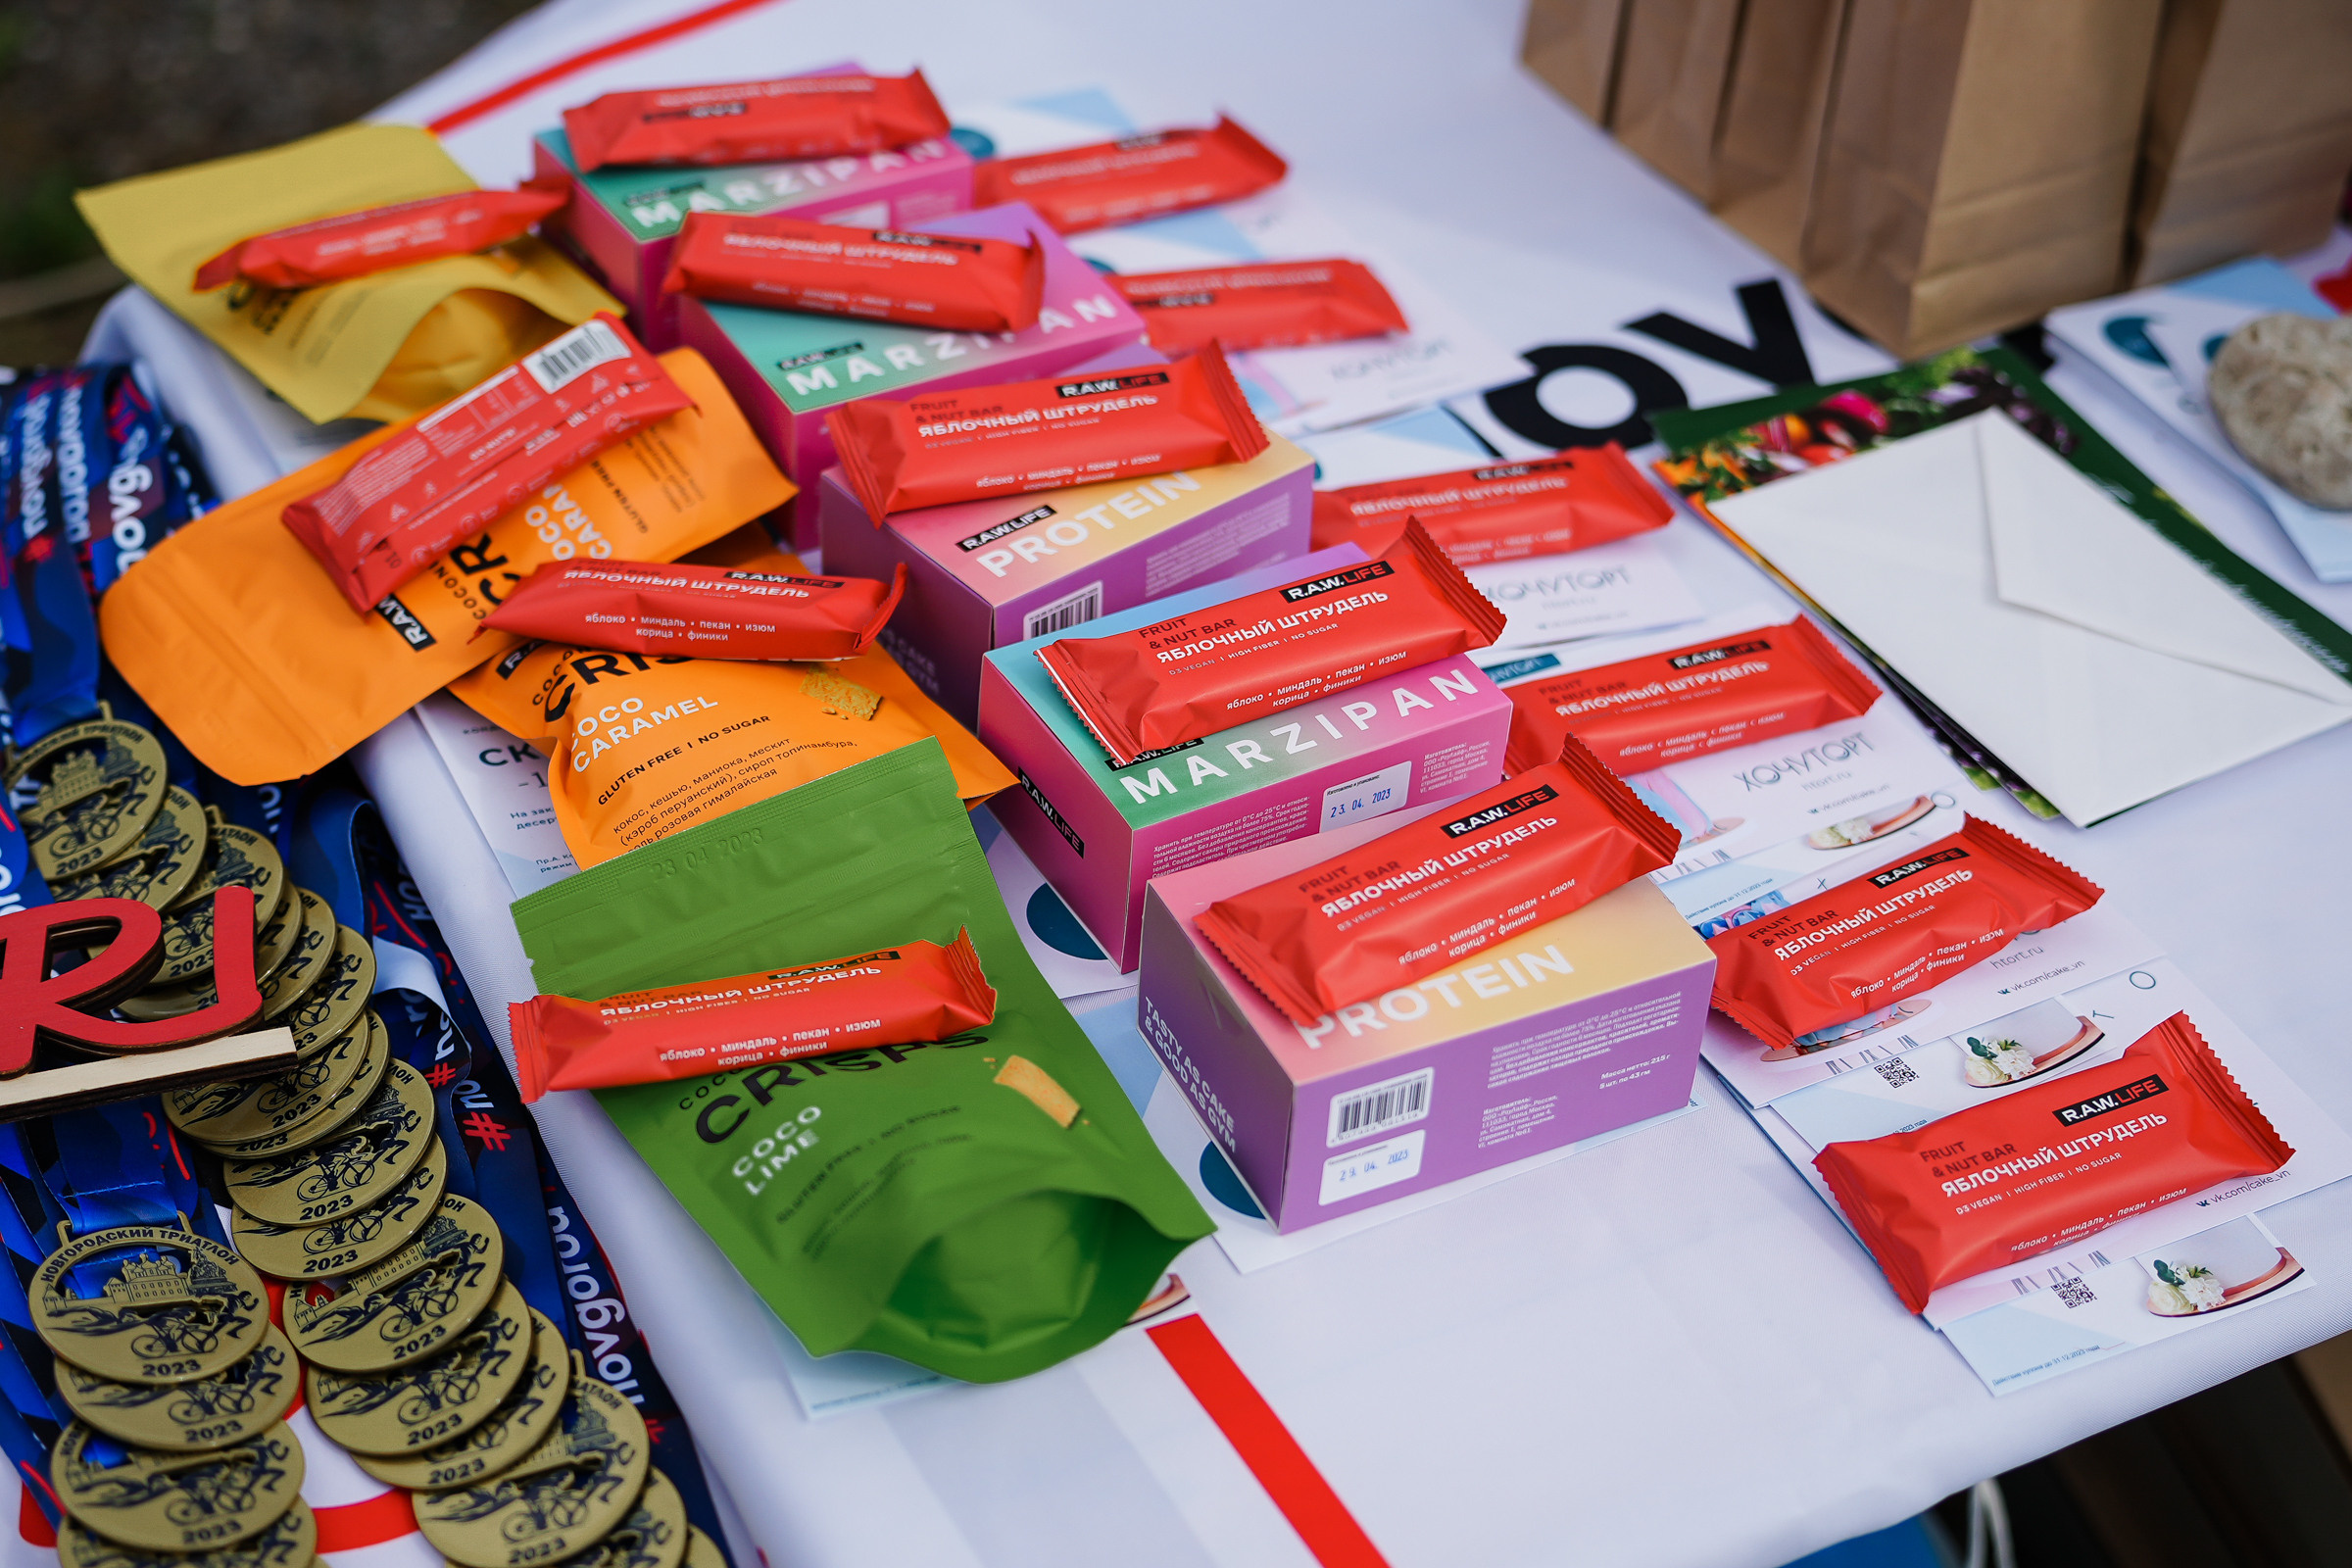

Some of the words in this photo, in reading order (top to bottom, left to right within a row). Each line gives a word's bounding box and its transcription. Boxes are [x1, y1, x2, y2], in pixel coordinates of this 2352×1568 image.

[786, 294, 1119, 396] MARZAN
[918, 409, 1040, 438] ЯБЛОЧНЫЙ
[1043, 395, 1158, 420] ШТРУДЕЛЬ
[976, 470, 1201, 578] PROTEIN
[564, 569, 686, 588] ЯБЛОЧНЫЙ
[690, 580, 809, 598] ШТРУДЕЛЬ
[1288, 564, 1386, 600] R.A.W.LIFE
[586, 613, 626, 624] яблоко
[641, 615, 686, 627] миндаль
[700, 619, 731, 631] пекан
[745, 623, 776, 633] изюм
[636, 627, 674, 639] корица
[688, 630, 729, 641] финики
[1138, 617, 1188, 639] FRUIT
[1150, 640, 1161, 650] &
[1163, 628, 1198, 646] NUT
[1203, 618, 1237, 635] BAR
[1156, 619, 1276, 663] ЯБЛОЧНЫЙ
[1277, 590, 1389, 630] ШТРУДЕЛЬ
[1183, 659, 1215, 671] VEGAN
[1228, 648, 1251, 659] HIGH
[1252, 640, 1280, 654] FIBER
[1307, 623, 1339, 636] SUGAR
[1226, 693, 1263, 710] яблоко
[1277, 676, 1323, 695] миндаль
[1336, 663, 1365, 678] пекан
[1378, 651, 1406, 665] изюм
[1273, 690, 1310, 708] корица
[1323, 674, 1362, 693] финики
[1555, 681, 1666, 716] ЯБЛОЧНЫЙ
[1665, 662, 1770, 693] ШТРУДЕЛЬ
[573, 695, 719, 773] CARAMEL
[1118, 668, 1479, 806] MARZIPAN
[1666, 730, 1707, 747] миндаль
[598, 763, 646, 807] GLUTEN
[647, 746, 683, 768] FREE
[698, 731, 719, 745] NO
[722, 714, 771, 735] SUGAR
[612, 806, 650, 835] кокос,
[649, 783, 691, 810] кешью,
[693, 756, 748, 785] маниока,
[748, 737, 791, 760] мескит
[619, 814, 659, 847] (кэроб
[660, 770, 737, 821] перуанский),
[739, 755, 775, 778] сироп
[775, 739, 858, 762] топинамбура,
[655, 807, 702, 842] розовая
[702, 767, 778, 811] гималайская
[1351, 799, 1364, 811] 04.
[1372, 788, 1392, 805] 2023
[516, 817, 558, 830] десер
[1021, 774, 1080, 851] R.A.W.LIFE
[1448, 789, 1550, 835] R.A.W.LIFE
[56, 845, 103, 876] 2023
[1153, 840, 1180, 853] Хранить
[1320, 858, 1445, 917] ЯБЛОЧНЫЙ
[1443, 815, 1558, 867] ШТРУДЕЛЬ
[1875, 850, 1963, 885] R.A.W.LIFE
[1298, 865, 1348, 894] FRUIT
[1328, 876, 1362, 899] NUT
[1364, 859, 1402, 881] BAR
[1396, 889, 1422, 904] HIGH
[1423, 877, 1450, 894] FIBER
[1462, 866, 1476, 877] NO
[1478, 853, 1510, 869] SUGAR
[1397, 943, 1438, 965] яблоко
[1449, 916, 1494, 943] миндаль
[1507, 897, 1537, 917] пекан
[1549, 877, 1575, 898] изюм
[1448, 933, 1486, 957] корица
[1497, 910, 1537, 936] финики
[1748, 914, 1792, 940] FRUIT
[1762, 937, 1776, 947] &
[1776, 924, 1807, 942] NUT
[1809, 909, 1839, 927] BAR
[1774, 908, 1878, 961] ЯБЛОЧНЫЙ
[1875, 868, 1974, 915] ШТРУДЕЛЬ
[1802, 949, 1832, 967] VEGAN
[1841, 935, 1863, 949] HIGH
[1863, 925, 1886, 940] FIBER
[1894, 915, 1907, 925] NO
[1907, 904, 1936, 919] SUGAR
[1850, 978, 1884, 999] яблоко
[1893, 955, 1927, 979] миндаль
[1936, 941, 1967, 956] пекан
[1891, 970, 1919, 993] корица
[1926, 953, 1965, 971] финики
[1989, 945, 2044, 970] htort.ru
[2011, 959, 2085, 992] vk.com/cake_vn
[600, 988, 743, 1017] ЯБЛОЧНЫЙ
[748, 966, 883, 995] ШТРУДЕЛЬ
[1294, 944, 1575, 1051] PROTEIN
[660, 1047, 706, 1063] яблоко
[721, 1035, 777, 1054] миндаль
[793, 1027, 830, 1043] пекан
[845, 1018, 881, 1033] изюм
[717, 1052, 763, 1066] корица
[779, 1041, 828, 1058] финики
[1145, 1016, 1153, 1035] &
[1155, 1030, 1189, 1084] GOOD
[1190, 1082, 1206, 1110] AS
[1208, 1106, 1236, 1153] GYM
[1146, 997, 1183, 1056] TASTY
[1184, 1055, 1200, 1084] AS
[1201, 1080, 1235, 1134] CAKE
[272, 1094, 321, 1127] 2023
[696, 1034, 989, 1144] CRISPS
[2061, 1078, 2160, 1122] R.A.W.LIFE
[732, 1105, 822, 1177] COCO
[745, 1129, 820, 1197] LIME
[1920, 1141, 1966, 1163] FRUIT
[1932, 1166, 1944, 1178] &
[1945, 1155, 1980, 1175] NUT
[1983, 1143, 2018, 1162] BAR
[1941, 1147, 2059, 1199] ЯБЛОЧНЫЙ
[2057, 1113, 2169, 1158] ШТРУДЕЛЬ
[1970, 1194, 2002, 1210] VEGAN
[2014, 1181, 2038, 1196] HIGH
[2038, 1171, 2065, 1186] FIBER
[2076, 1162, 2090, 1173] NO
[2090, 1152, 2123, 1167] SUGAR
[2210, 1170, 2290, 1204] vk.com/cake_vn
[300, 1196, 354, 1221] 2023
[2011, 1235, 2047, 1252] яблоко
[2061, 1215, 2105, 1237] миндаль
[2117, 1200, 2146, 1218] пекан
[2159, 1187, 2186, 1203] изюм
[40, 1227, 154, 1283] НОВГОРОДСКИЙ
[160, 1230, 240, 1266] ТРИАТЛОН
[305, 1250, 359, 1274] 2023
[393, 1325, 447, 1360] 2023
[143, 1359, 201, 1377] 2023
[185, 1421, 243, 1443] 2023
[408, 1413, 463, 1446] 2023
[428, 1458, 485, 1484] 2023
